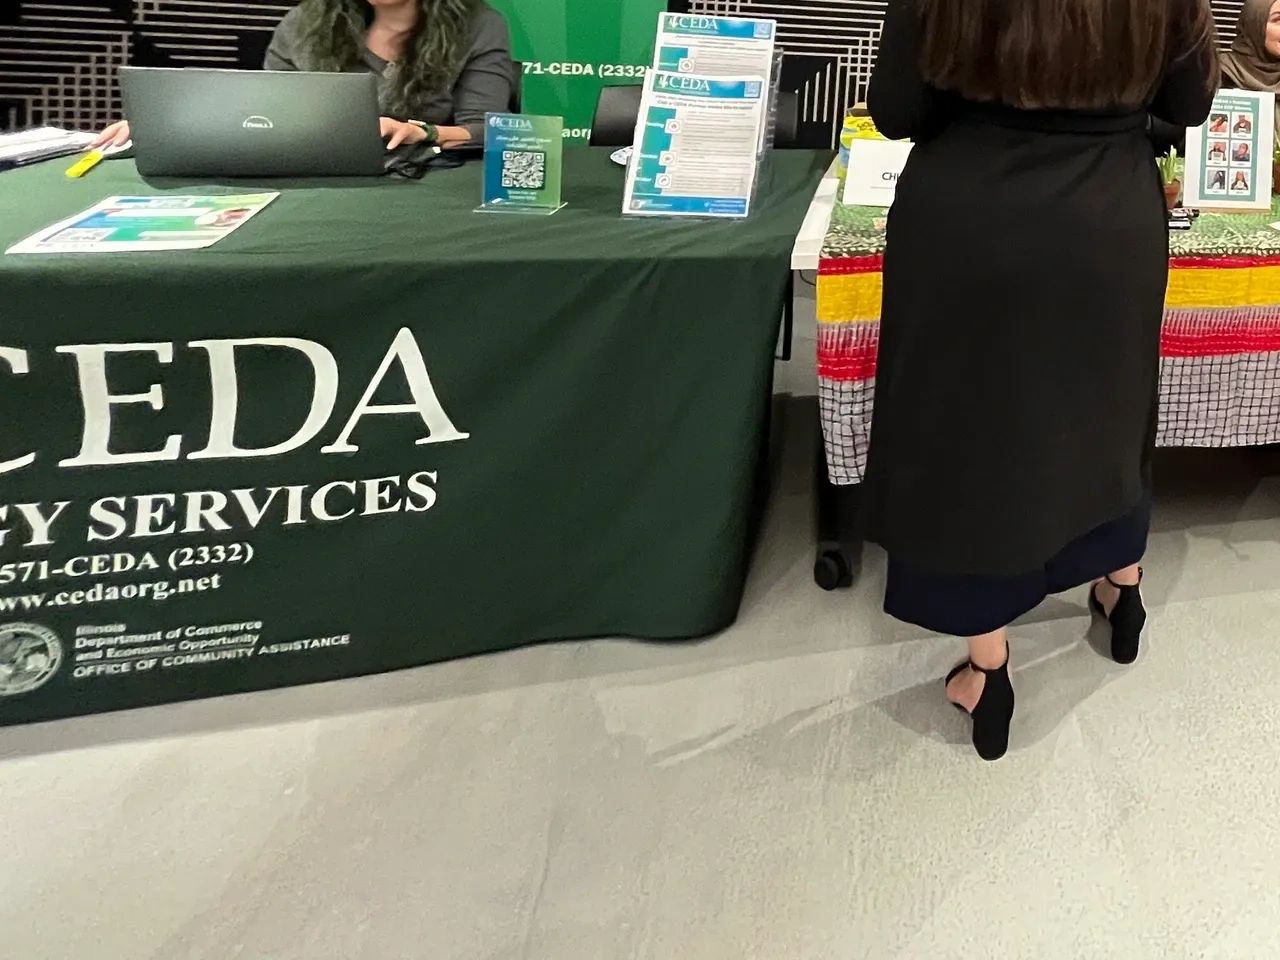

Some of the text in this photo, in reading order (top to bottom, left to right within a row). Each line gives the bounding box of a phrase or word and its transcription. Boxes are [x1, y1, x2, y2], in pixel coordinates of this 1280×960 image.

[679, 16, 719, 30] CEDA
[669, 77, 711, 91] CEDA
[0, 326, 471, 474] EDA
[86, 470, 439, 542] SERVICES
[168, 542, 254, 571] (2332)
[75, 629, 165, 650] Department
[166, 627, 181, 640] of
[184, 620, 263, 638] Commerce
[106, 642, 175, 659] Economic
[178, 633, 260, 652] Opportunity
[73, 633, 351, 679] OFFICE OF COMMUNITY ASSISTANCE
